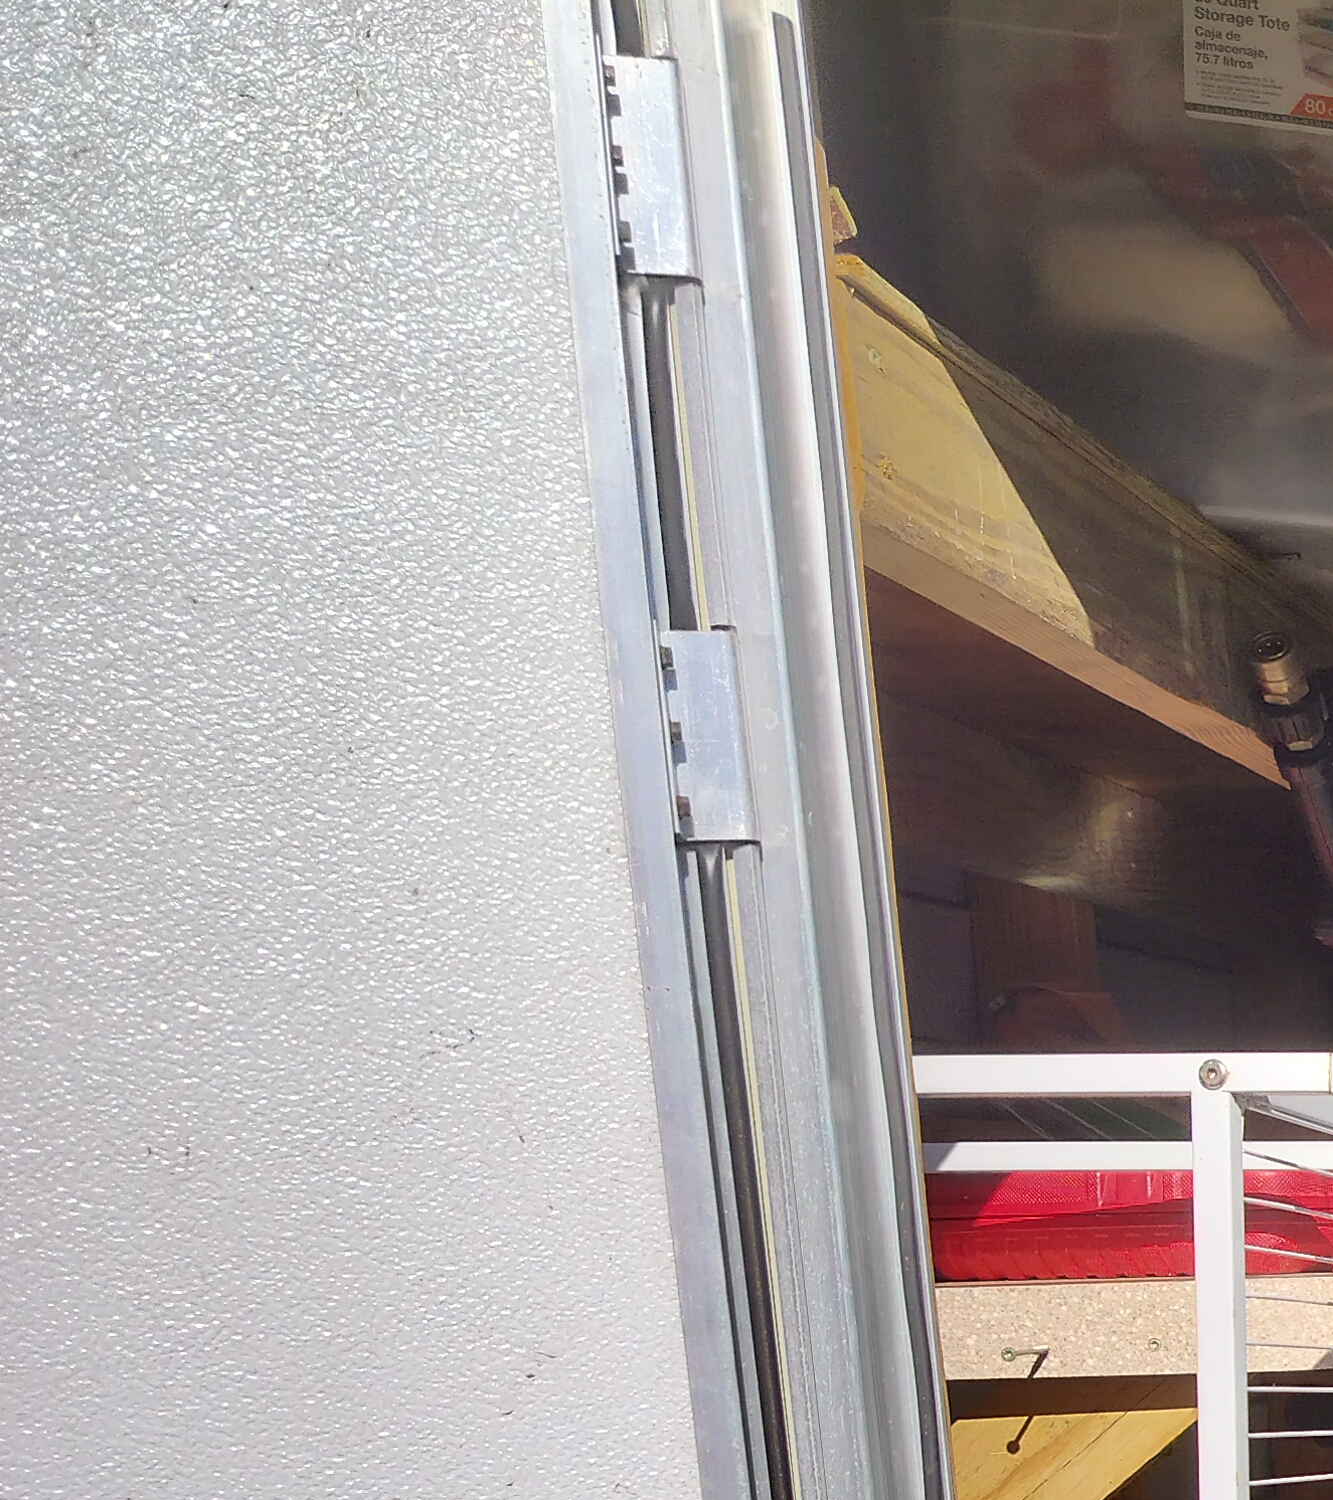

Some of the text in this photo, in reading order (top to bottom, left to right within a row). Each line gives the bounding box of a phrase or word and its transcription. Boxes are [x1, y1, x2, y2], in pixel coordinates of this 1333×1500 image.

[1194, 6, 1290, 32] Storage Tote
[1194, 25, 1241, 42] Caja de
[1194, 40, 1268, 60] almacenaje,
[1195, 52, 1254, 70] 75.7 litros
[1304, 98, 1326, 116] 80
